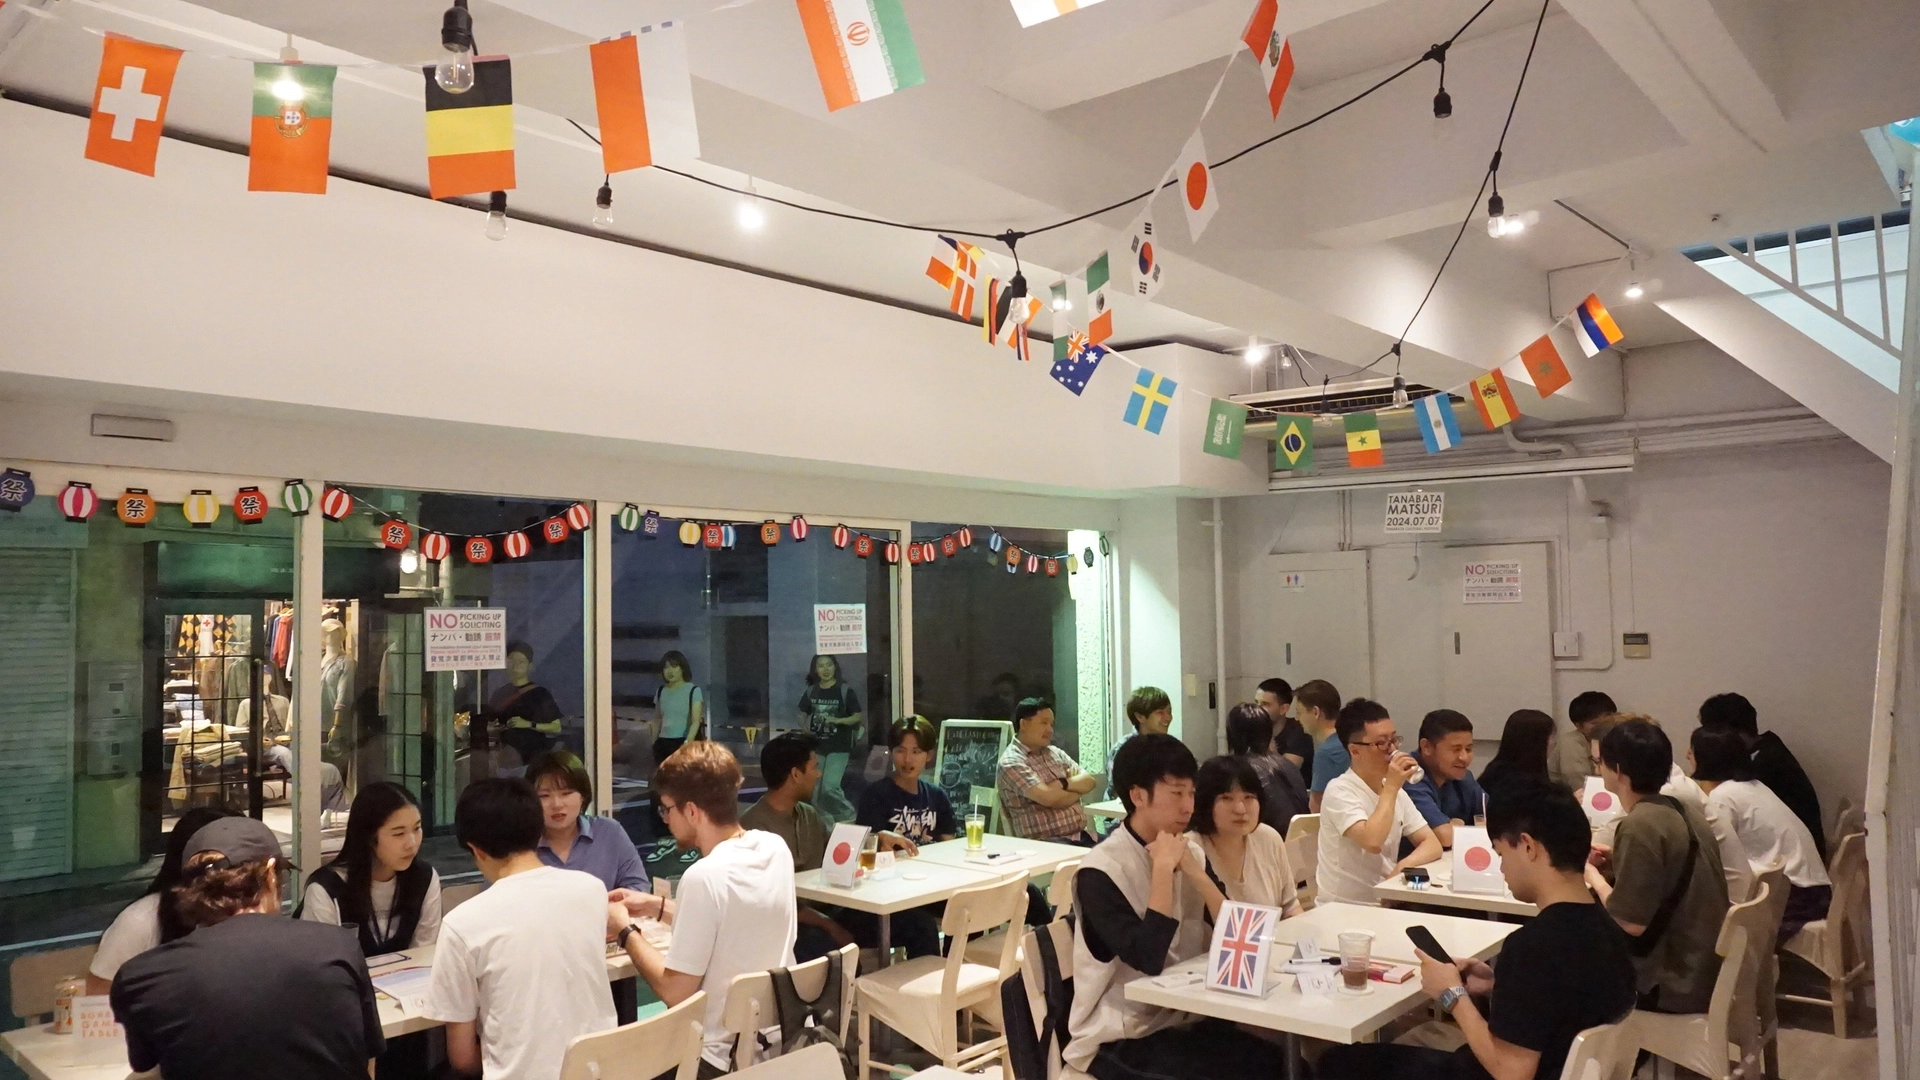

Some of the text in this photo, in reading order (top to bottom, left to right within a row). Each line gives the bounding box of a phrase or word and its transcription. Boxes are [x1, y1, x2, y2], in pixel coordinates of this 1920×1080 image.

[0, 478, 27, 502] 祭
[241, 496, 261, 515] 祭
[1389, 494, 1442, 503] TANABATA
[125, 498, 149, 518] 祭
[1388, 503, 1441, 514] MATSURI
[644, 516, 660, 534] 祭
[1387, 516, 1440, 526] 2024.07.07
[388, 525, 405, 544] 祭
[549, 521, 564, 539] 祭
[707, 529, 719, 544] 祭
[765, 526, 777, 541] 祭
[471, 541, 487, 559] 祭
[859, 538, 868, 553] 祭
[945, 540, 954, 552] 祭
[910, 547, 921, 560] 祭
[1465, 564, 1485, 574] NO
[430, 613, 458, 628] NO
[818, 610, 835, 621] NO
